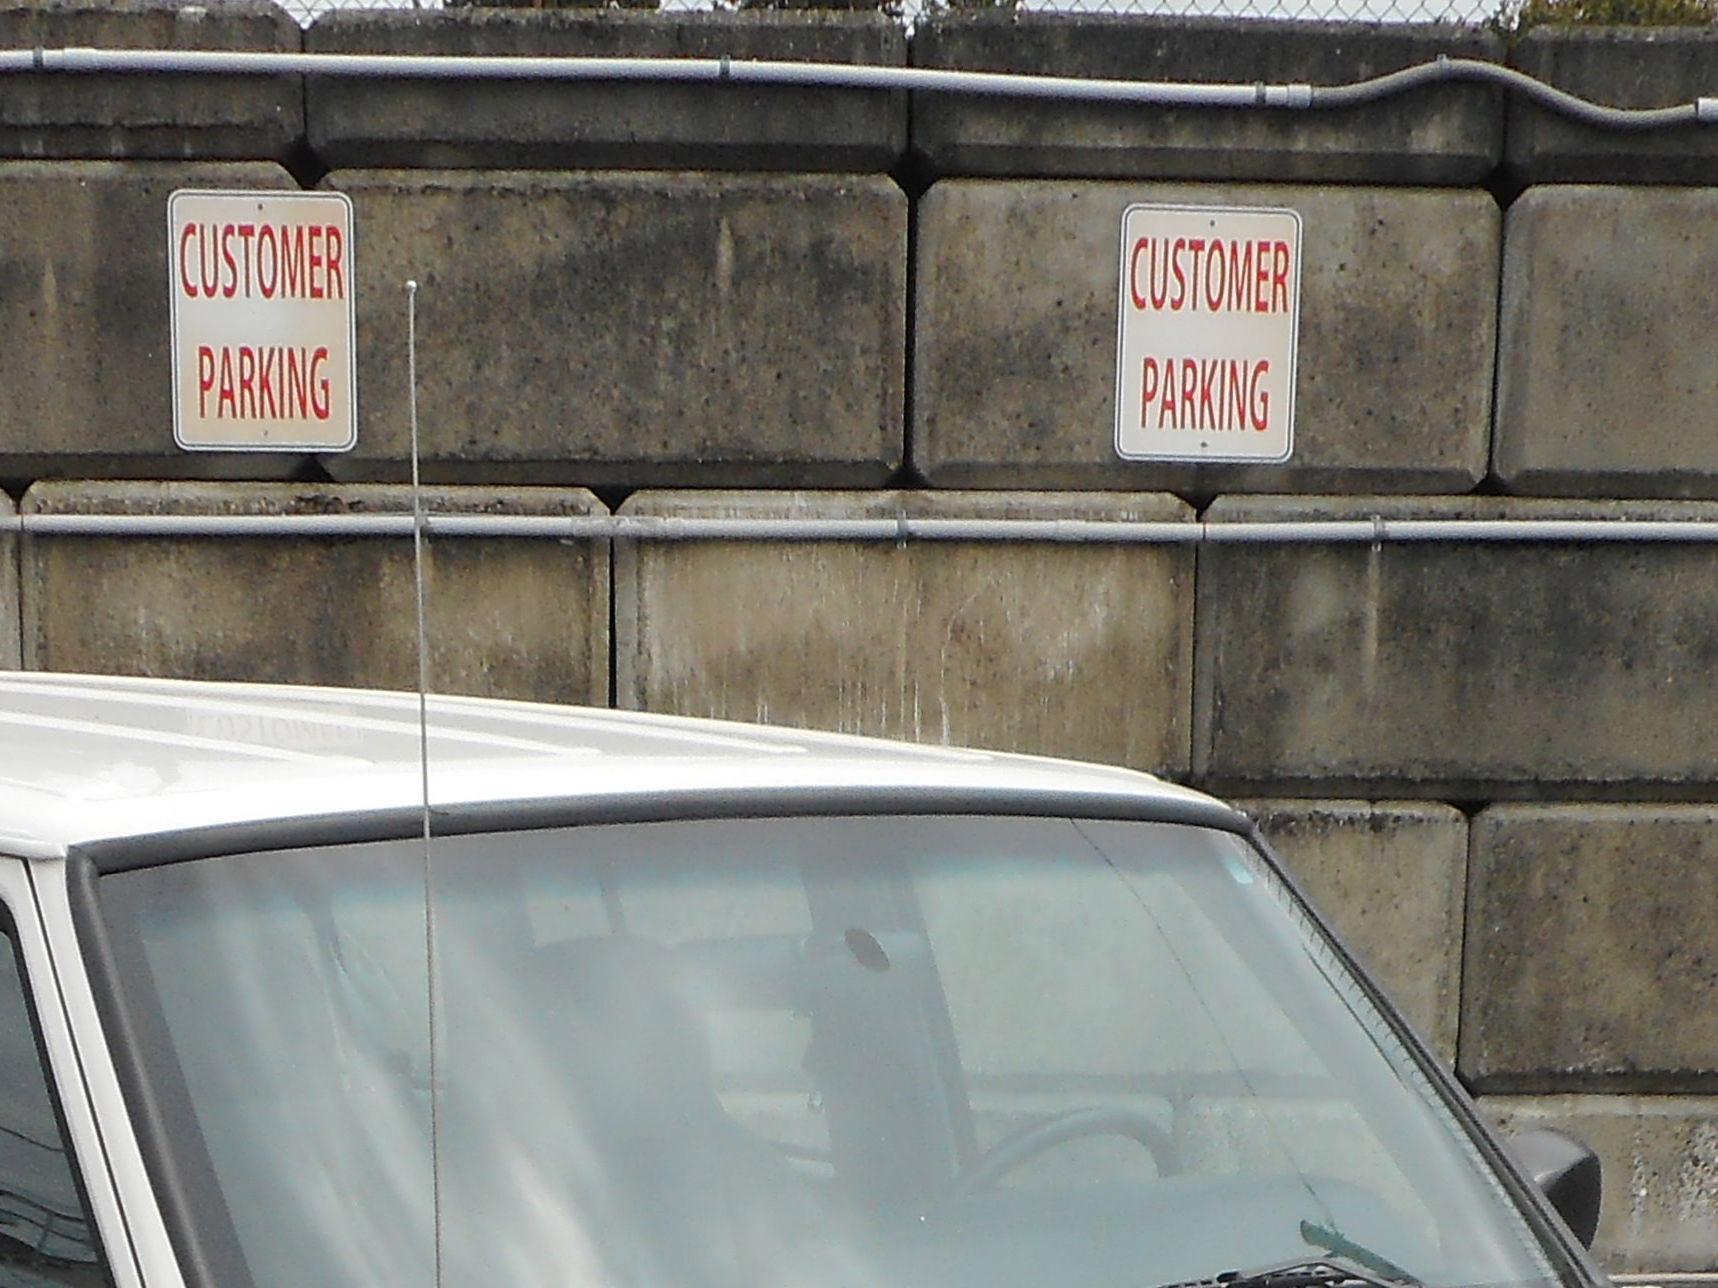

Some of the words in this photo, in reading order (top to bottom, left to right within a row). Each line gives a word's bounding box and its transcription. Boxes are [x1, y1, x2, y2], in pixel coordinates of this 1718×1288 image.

[182, 224, 343, 299] CUSTOMER
[1132, 237, 1290, 312] CUSTOMER
[199, 346, 332, 420] PARKING
[1142, 358, 1271, 431] PARKING
